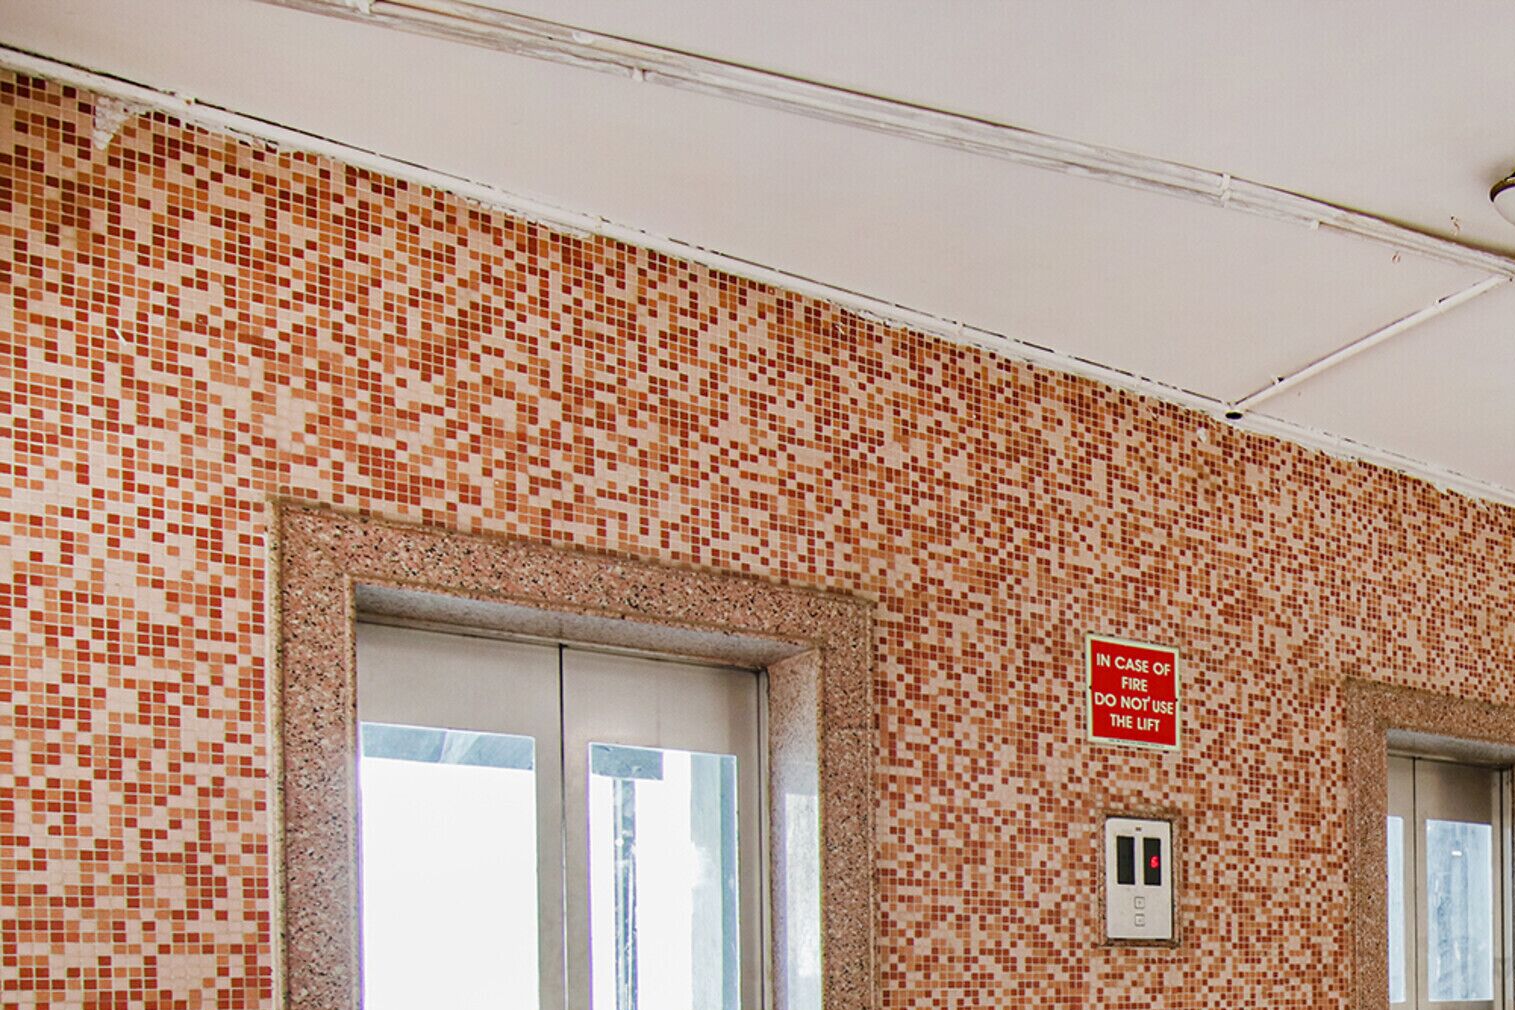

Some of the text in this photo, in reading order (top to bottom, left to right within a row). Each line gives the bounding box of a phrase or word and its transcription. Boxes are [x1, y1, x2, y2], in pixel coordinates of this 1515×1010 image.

[1096, 653, 1171, 676] IN CASE OF
[1121, 676, 1148, 693] FIRE
[1094, 691, 1174, 715] DO NOT USE
[1110, 713, 1160, 732] THE LIFT
